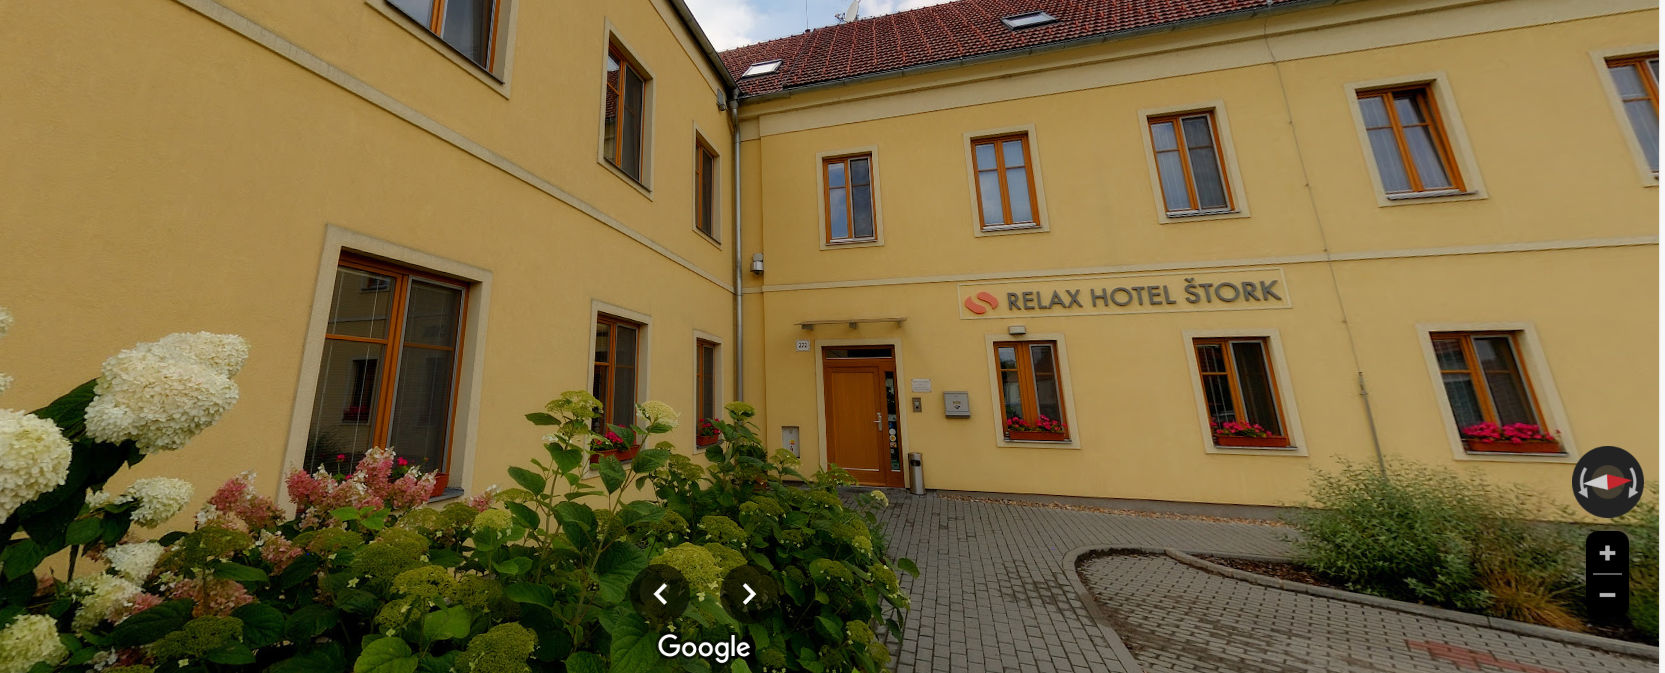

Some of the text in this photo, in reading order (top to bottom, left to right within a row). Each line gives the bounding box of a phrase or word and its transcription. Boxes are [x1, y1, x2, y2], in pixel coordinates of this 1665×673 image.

[1007, 277, 1282, 311] RELAX HOTEL ŠTORK
